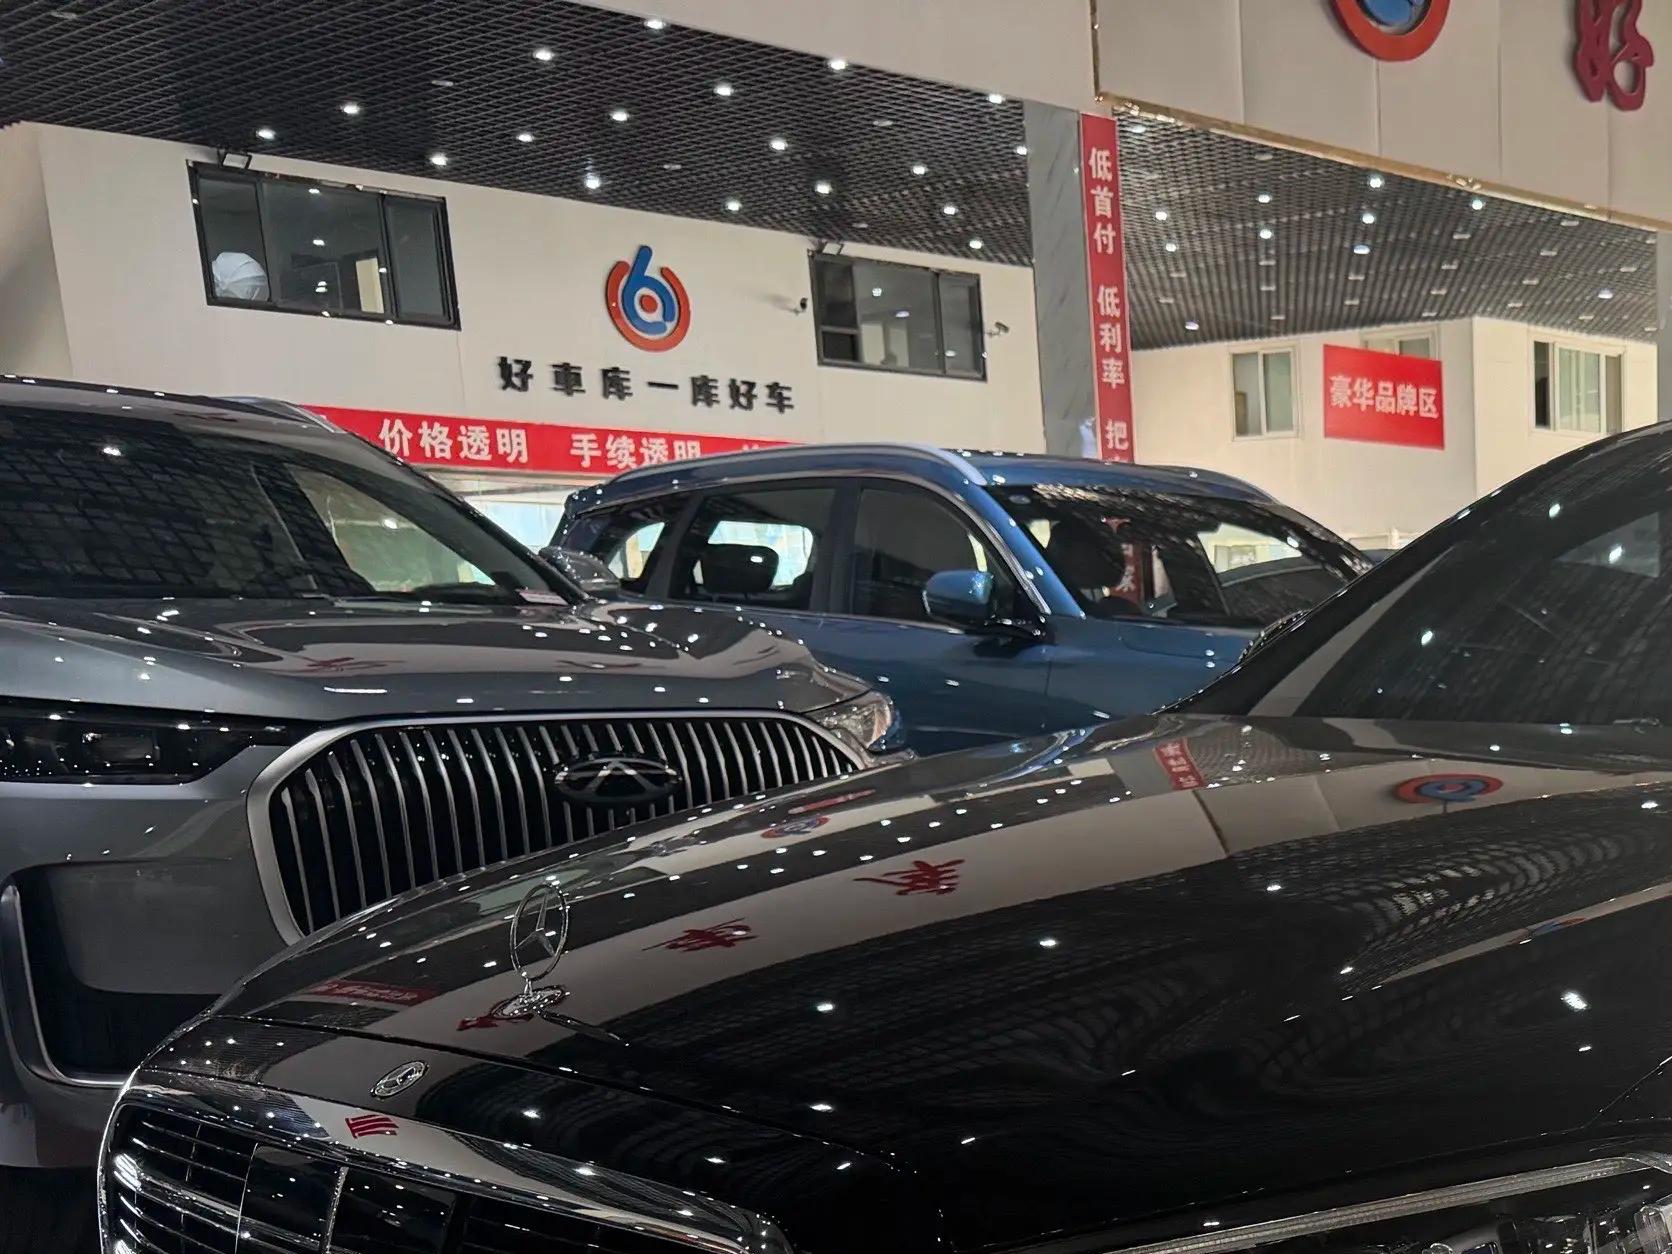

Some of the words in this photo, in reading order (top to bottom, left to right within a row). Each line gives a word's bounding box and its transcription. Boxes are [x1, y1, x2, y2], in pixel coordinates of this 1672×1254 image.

[1088, 146, 1116, 255] 低首付
[1097, 285, 1125, 390] 低利率
[1329, 375, 1438, 418] 豪华品牌区
[378, 418, 528, 463] 价格透明
[570, 432, 701, 468] 手续透明
[1105, 418, 1130, 460] 把
